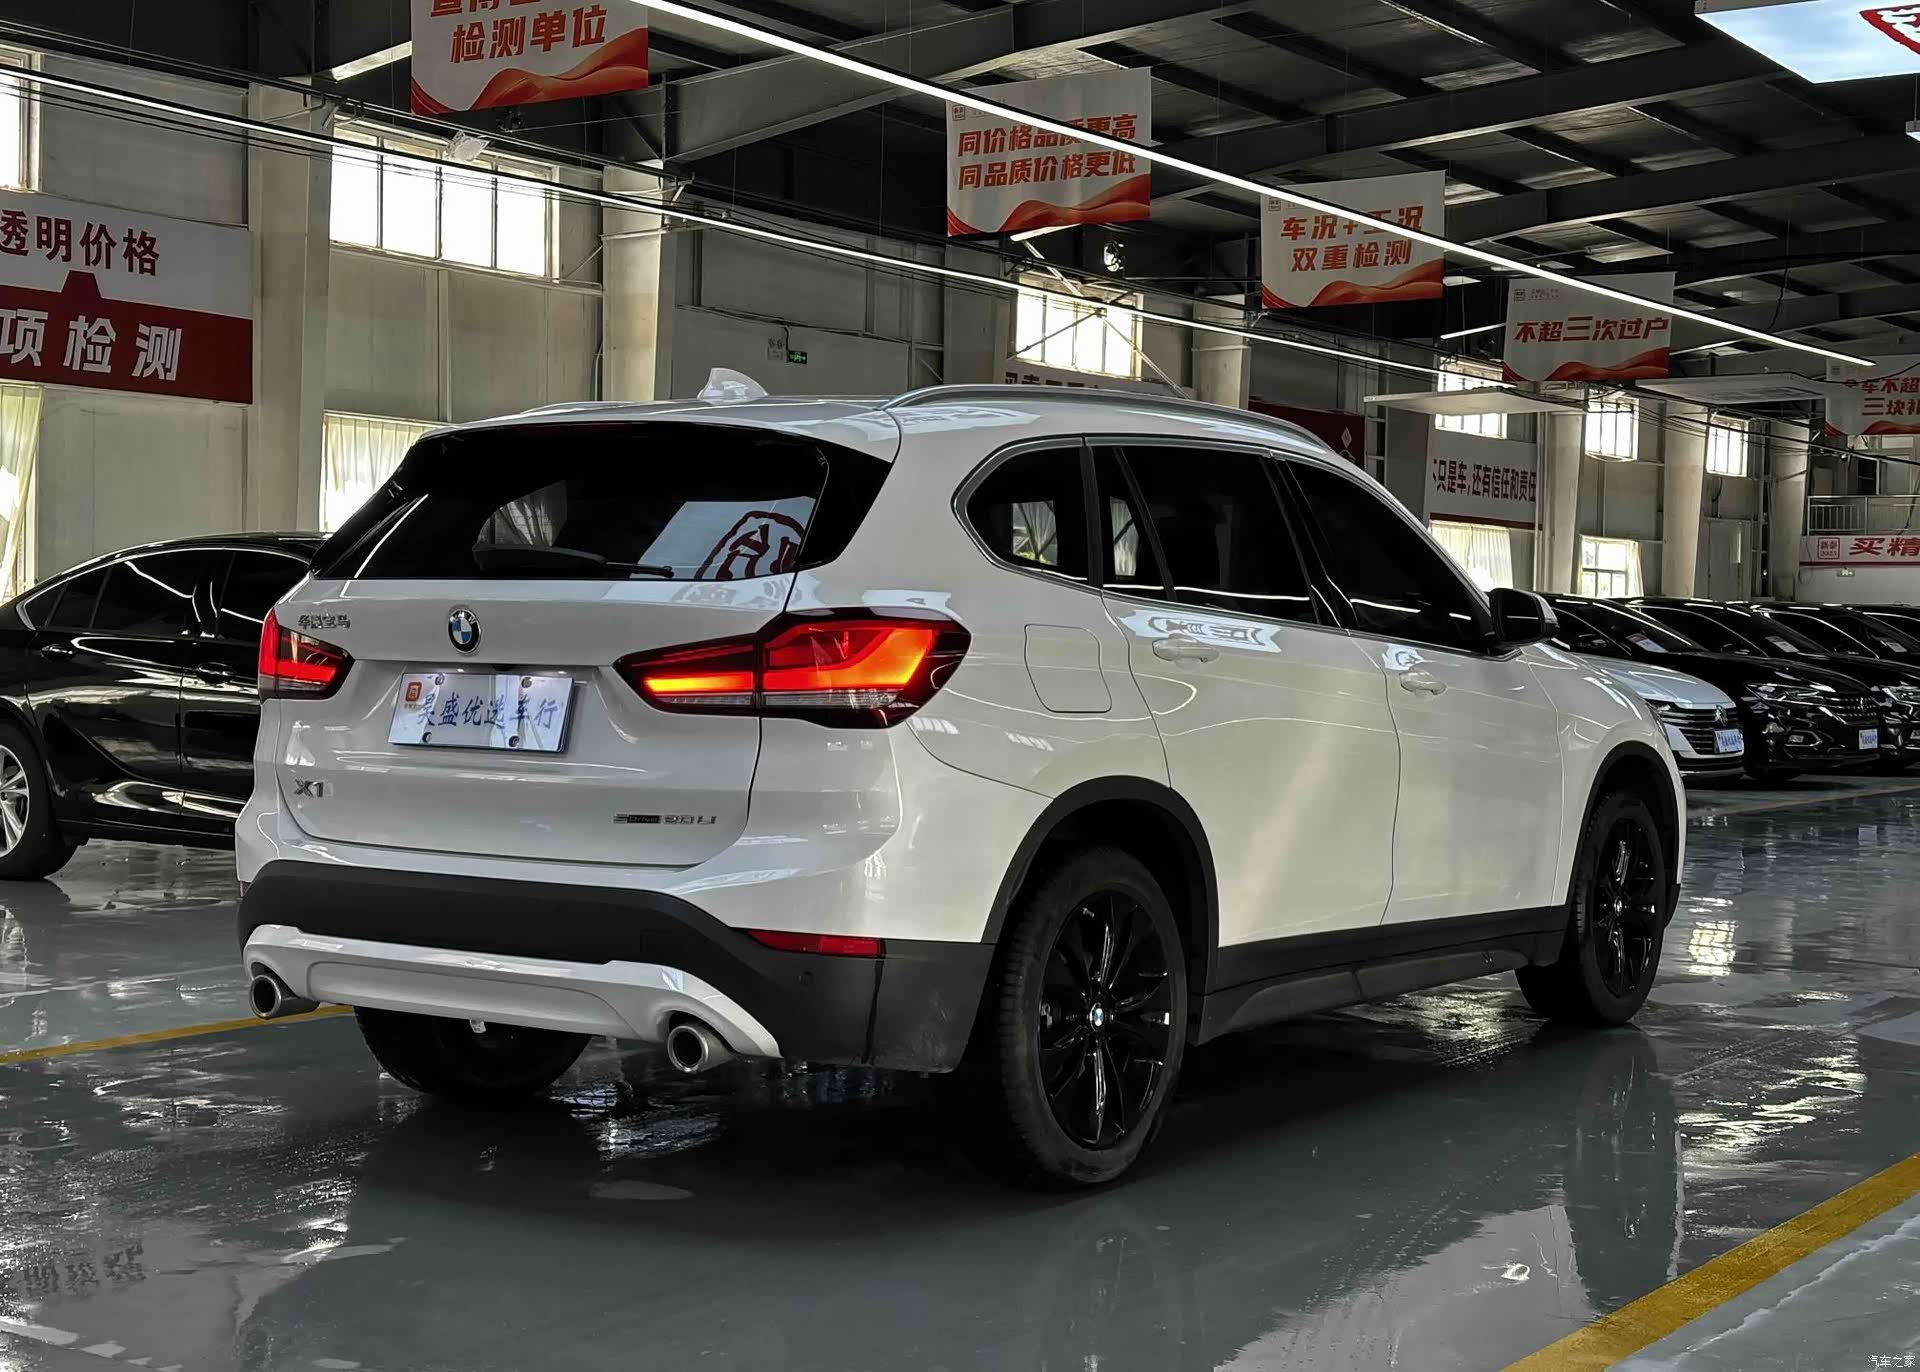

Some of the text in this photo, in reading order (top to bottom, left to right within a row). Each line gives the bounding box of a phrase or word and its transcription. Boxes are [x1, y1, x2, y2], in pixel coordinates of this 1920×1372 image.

[450, 5, 608, 64] 检测单位
[958, 149, 1136, 190] 同品质价格更低
[0, 208, 160, 276] 透明价格
[1291, 239, 1412, 272] 双重检测
[1514, 315, 1670, 343] 不超三次过户
[293, 778, 325, 798] X1
